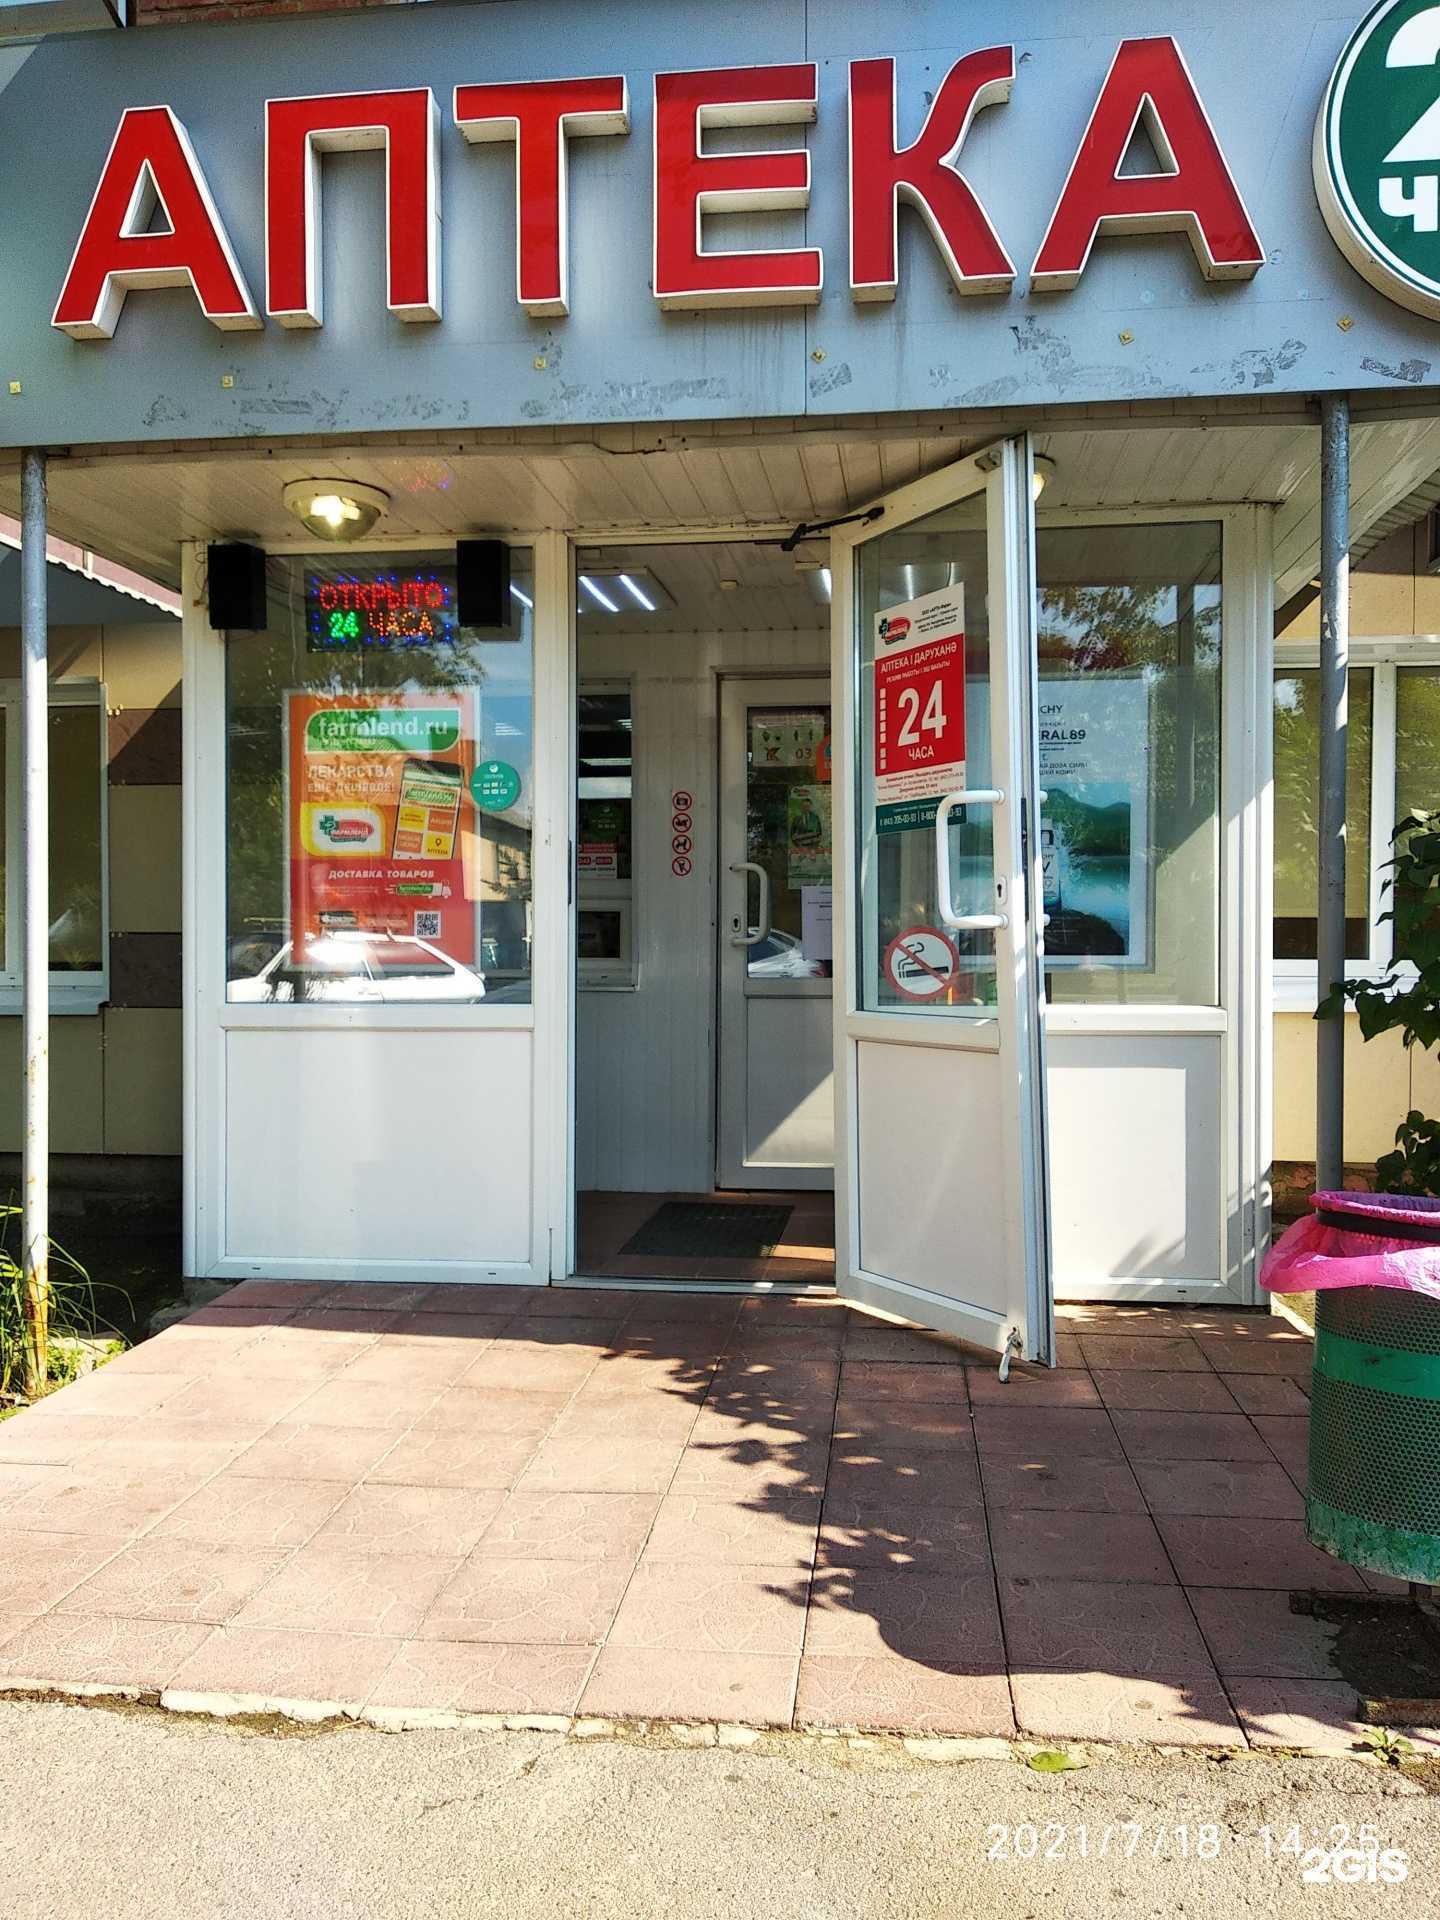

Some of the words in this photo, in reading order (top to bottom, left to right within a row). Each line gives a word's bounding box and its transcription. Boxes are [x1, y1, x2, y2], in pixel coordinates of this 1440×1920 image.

[52, 36, 1264, 336] АПТЕКА
[320, 582, 443, 609] ОТКРЫТО
[330, 611, 359, 637] 24
[368, 611, 434, 637] ЧАСА
[880, 656, 909, 673] АПТЕКА
[898, 680, 947, 747] 24
[1040, 704, 1063, 714] CHY
[318, 716, 448, 737] farmlend.ru
[908, 745, 935, 760] ЧАСА
[308, 765, 394, 779] ЛЕКАРСТВА
[328, 869, 383, 880] ДОСТАВКА
[387, 869, 435, 879] ТОВАРОВ
